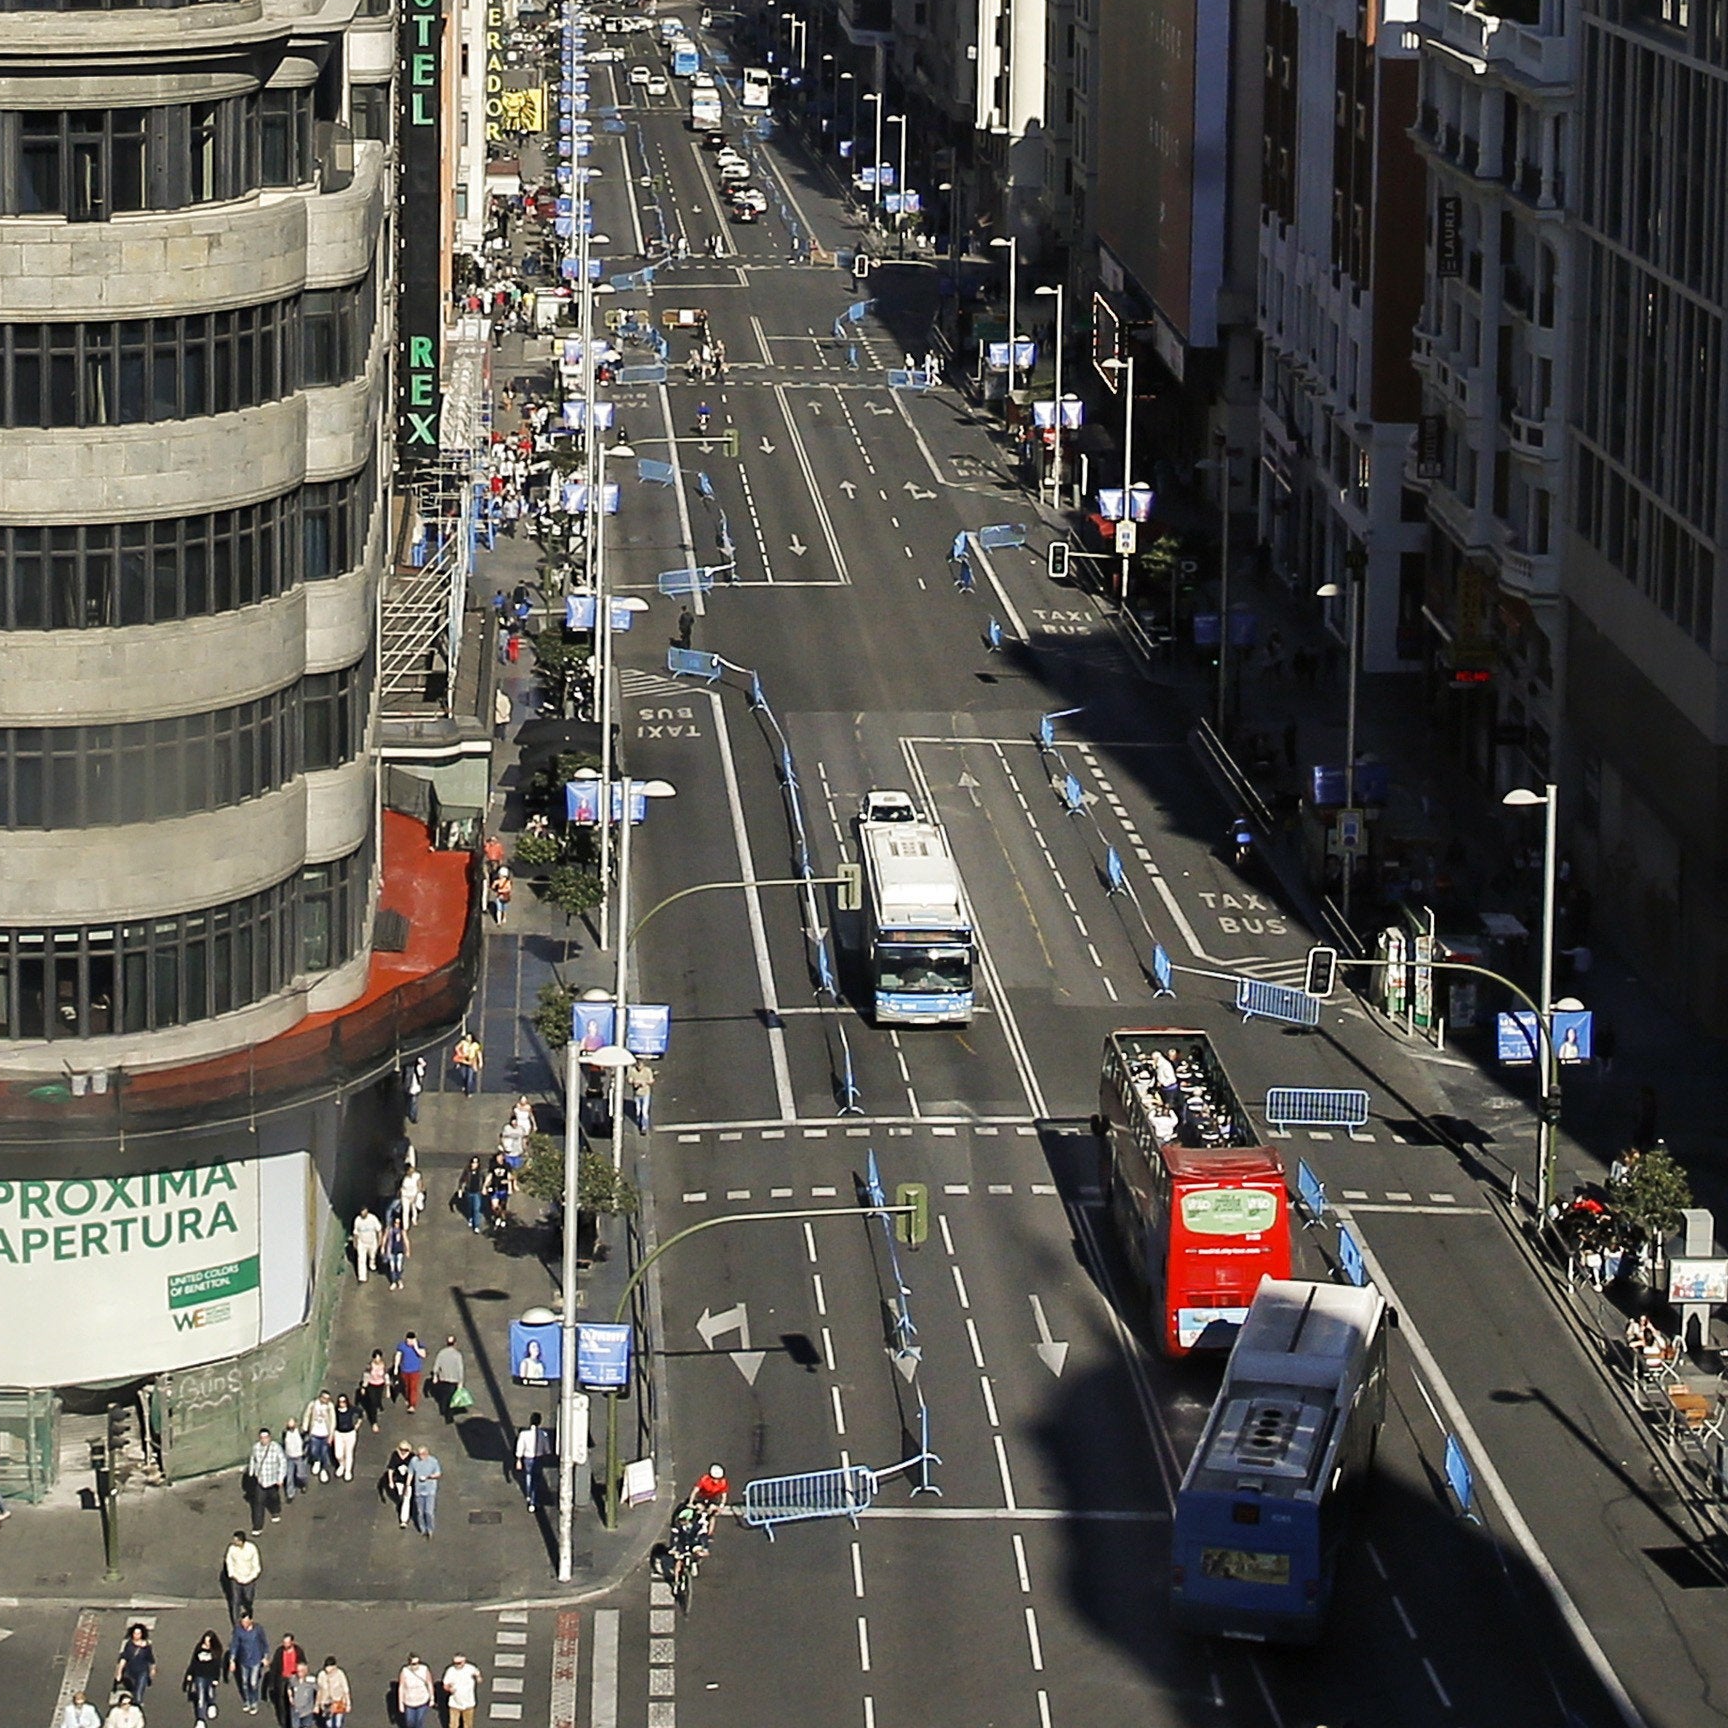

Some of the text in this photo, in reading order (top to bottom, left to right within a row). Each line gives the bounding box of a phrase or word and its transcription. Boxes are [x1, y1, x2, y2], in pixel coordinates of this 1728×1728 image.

[408, 336, 436, 446] REX
[1033, 609, 1092, 622] TAXI
[1042, 624, 1091, 635] BUS
[639, 708, 693, 720] BUS
[638, 725, 701, 738] TAXI
[1218, 917, 1287, 934] BUS
[170, 1264, 240, 1286] UNITED COLORS
[170, 1287, 183, 1297] OF
[173, 1309, 206, 1332] WE
